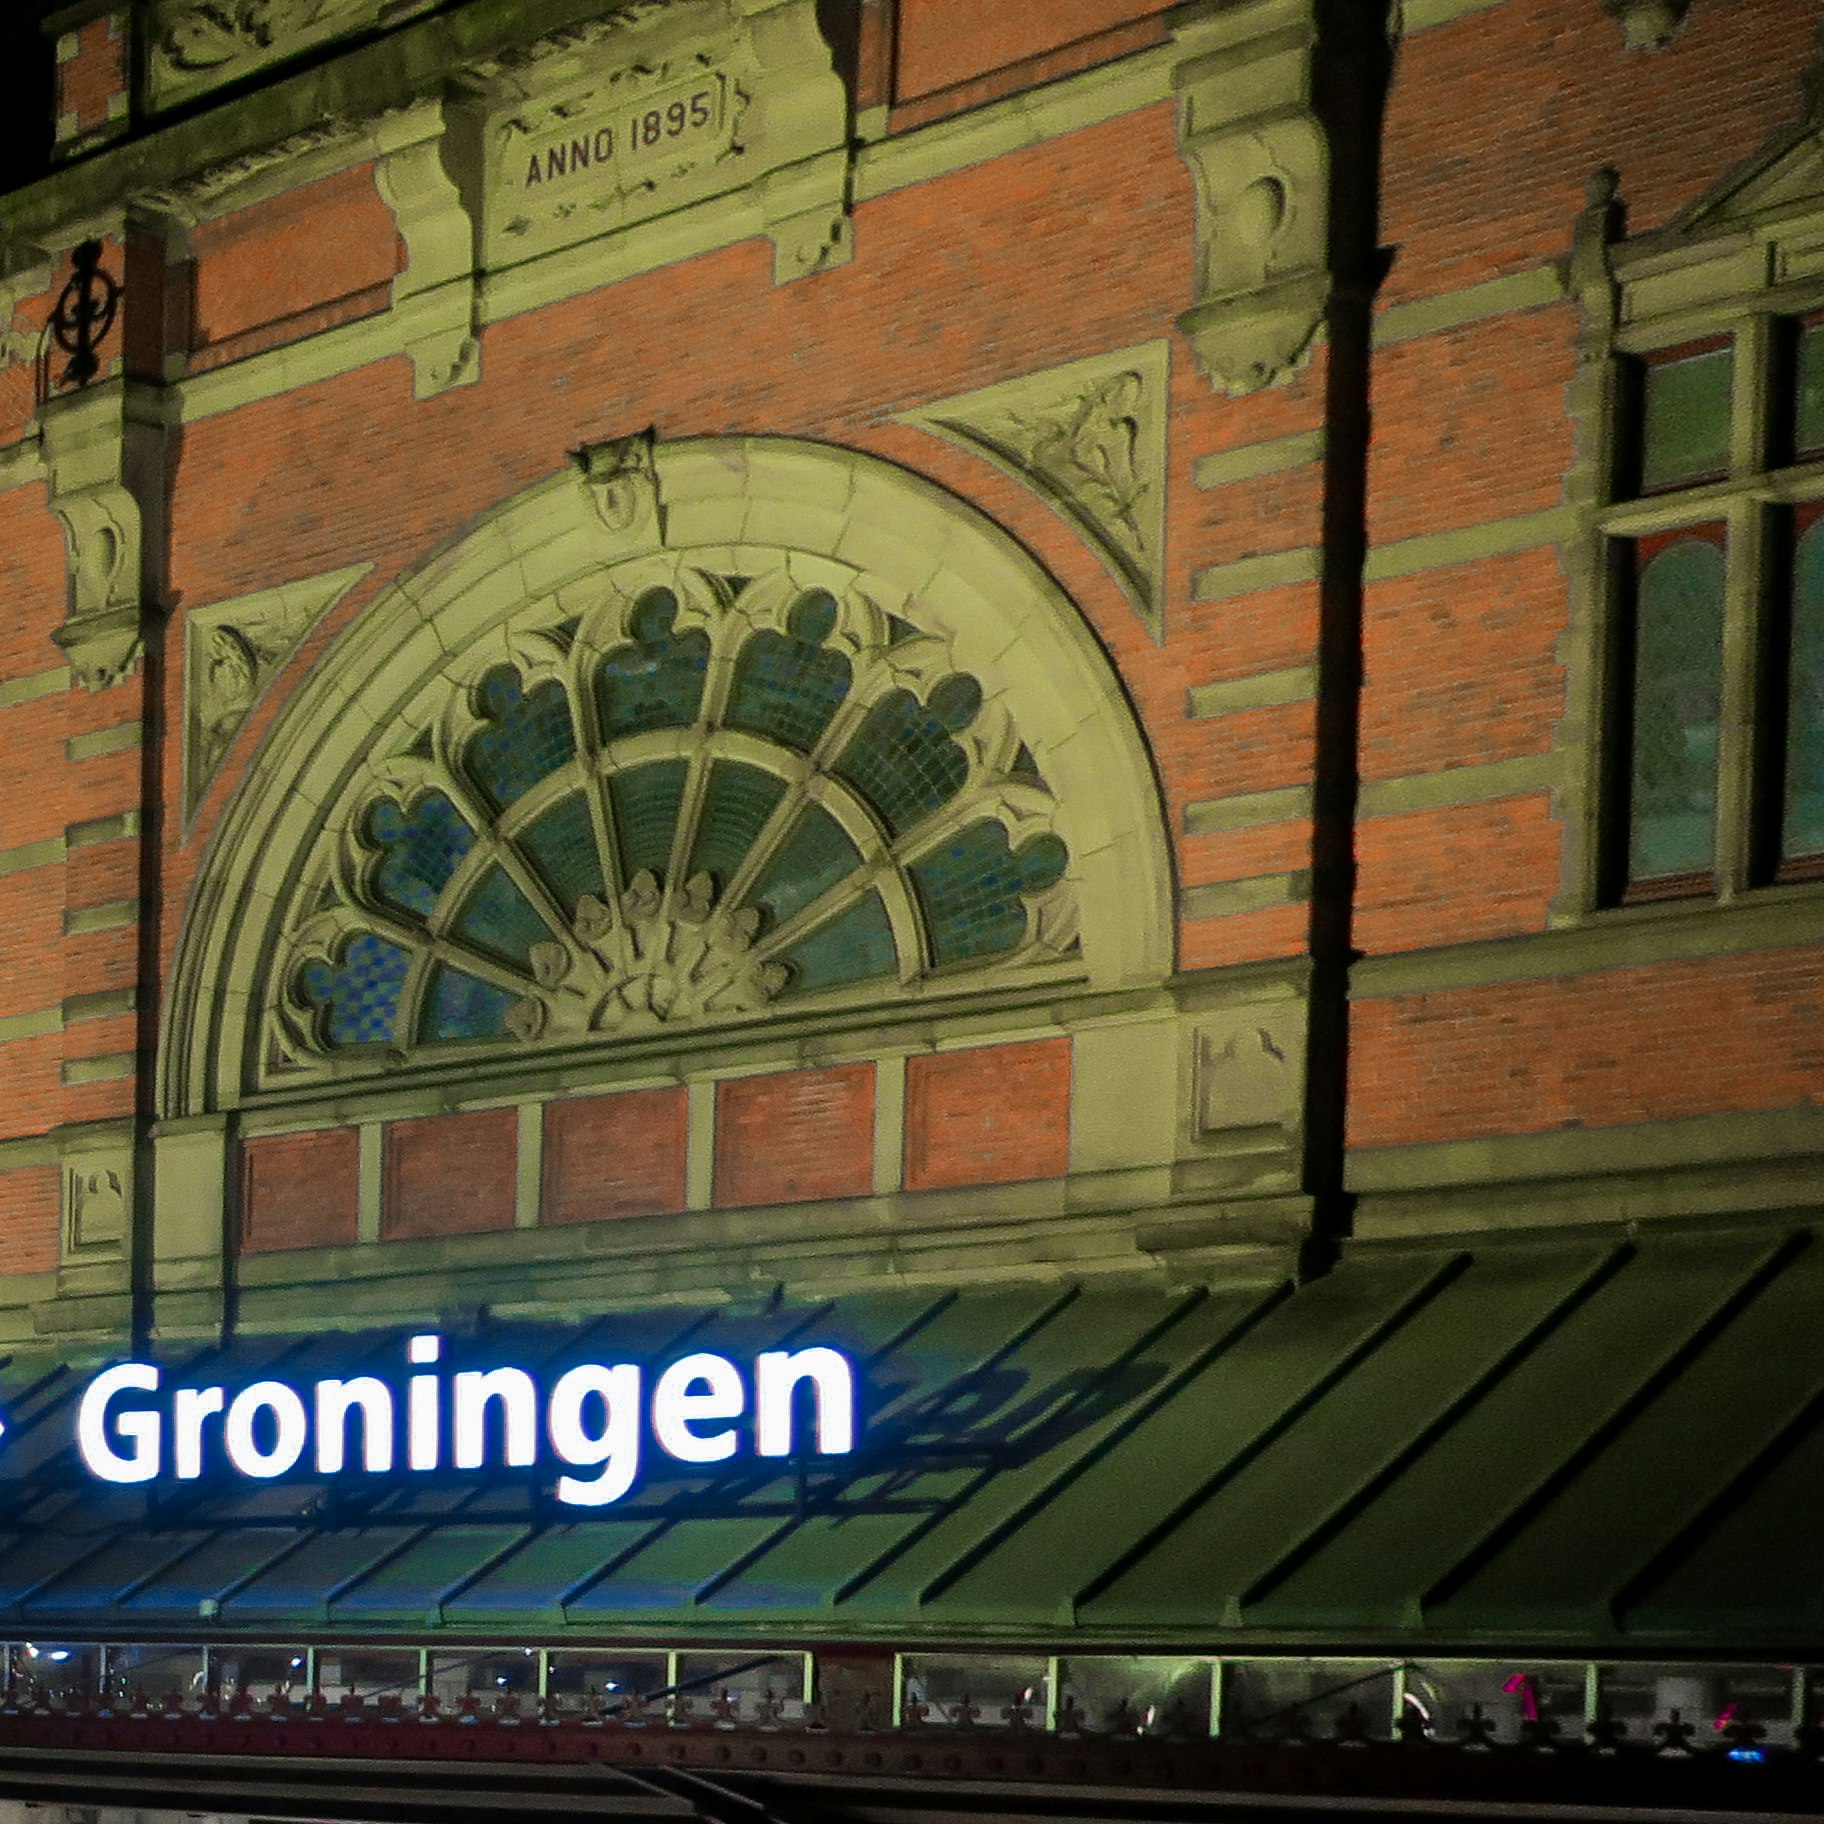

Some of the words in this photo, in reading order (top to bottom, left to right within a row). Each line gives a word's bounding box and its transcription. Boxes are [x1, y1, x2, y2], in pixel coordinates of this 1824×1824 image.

[527, 129, 612, 186] ANNO
[633, 92, 709, 149] 1895
[76, 1334, 854, 1507] Groningen
